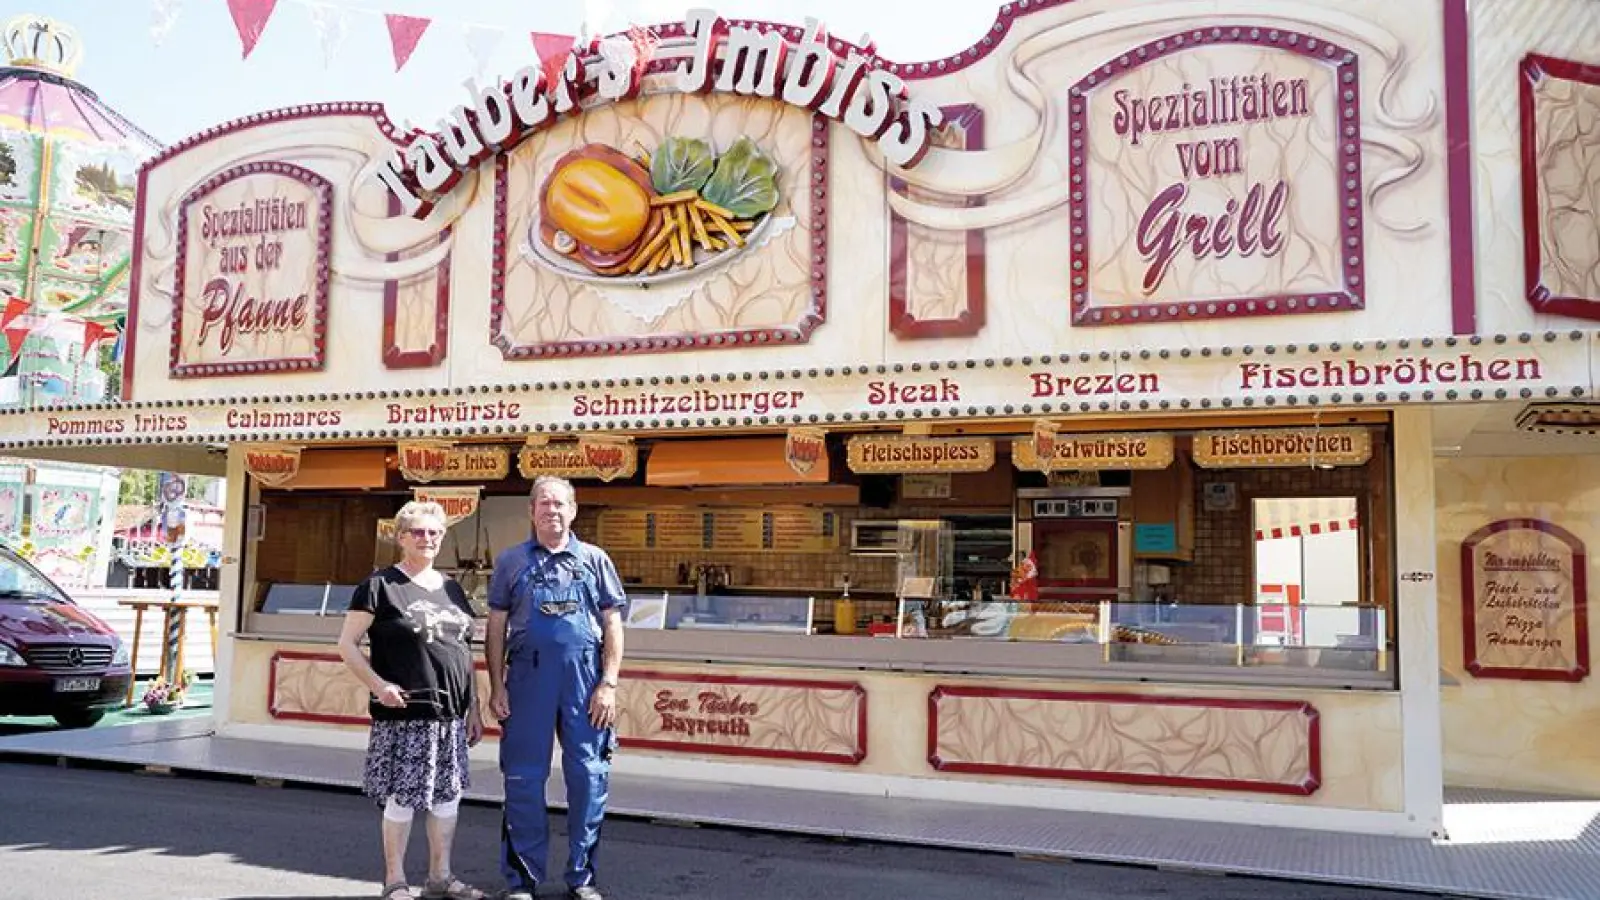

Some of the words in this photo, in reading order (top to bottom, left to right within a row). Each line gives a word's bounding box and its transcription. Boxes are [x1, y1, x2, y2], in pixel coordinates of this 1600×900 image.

[681, 8, 942, 167] Imbiss
[1113, 73, 1309, 144] Spezialitäten
[1176, 137, 1242, 178] vom
[202, 199, 306, 248] Spezialitäten
[1137, 180, 1288, 294] Grill
[220, 244, 248, 274] aus
[256, 236, 283, 271] der
[198, 278, 307, 354] Pfanne
[48, 416, 124, 435] Pommes
[226, 408, 342, 430] Calamares
[387, 400, 521, 424] Bratwürste
[573, 389, 805, 418] Schnitzelburger
[868, 379, 960, 405] Steak
[1030, 372, 1160, 398] Brezen
[1240, 354, 1543, 390] Fischbrötchen
[861, 437, 980, 465] Fleischspiess
[1053, 439, 1147, 458] ratwürste
[1211, 433, 1353, 456] Fischbrötchen
[1486, 631, 1562, 651] Hamburger
[1505, 615, 1543, 633] Pizza
[661, 713, 750, 736] Bayreuth
